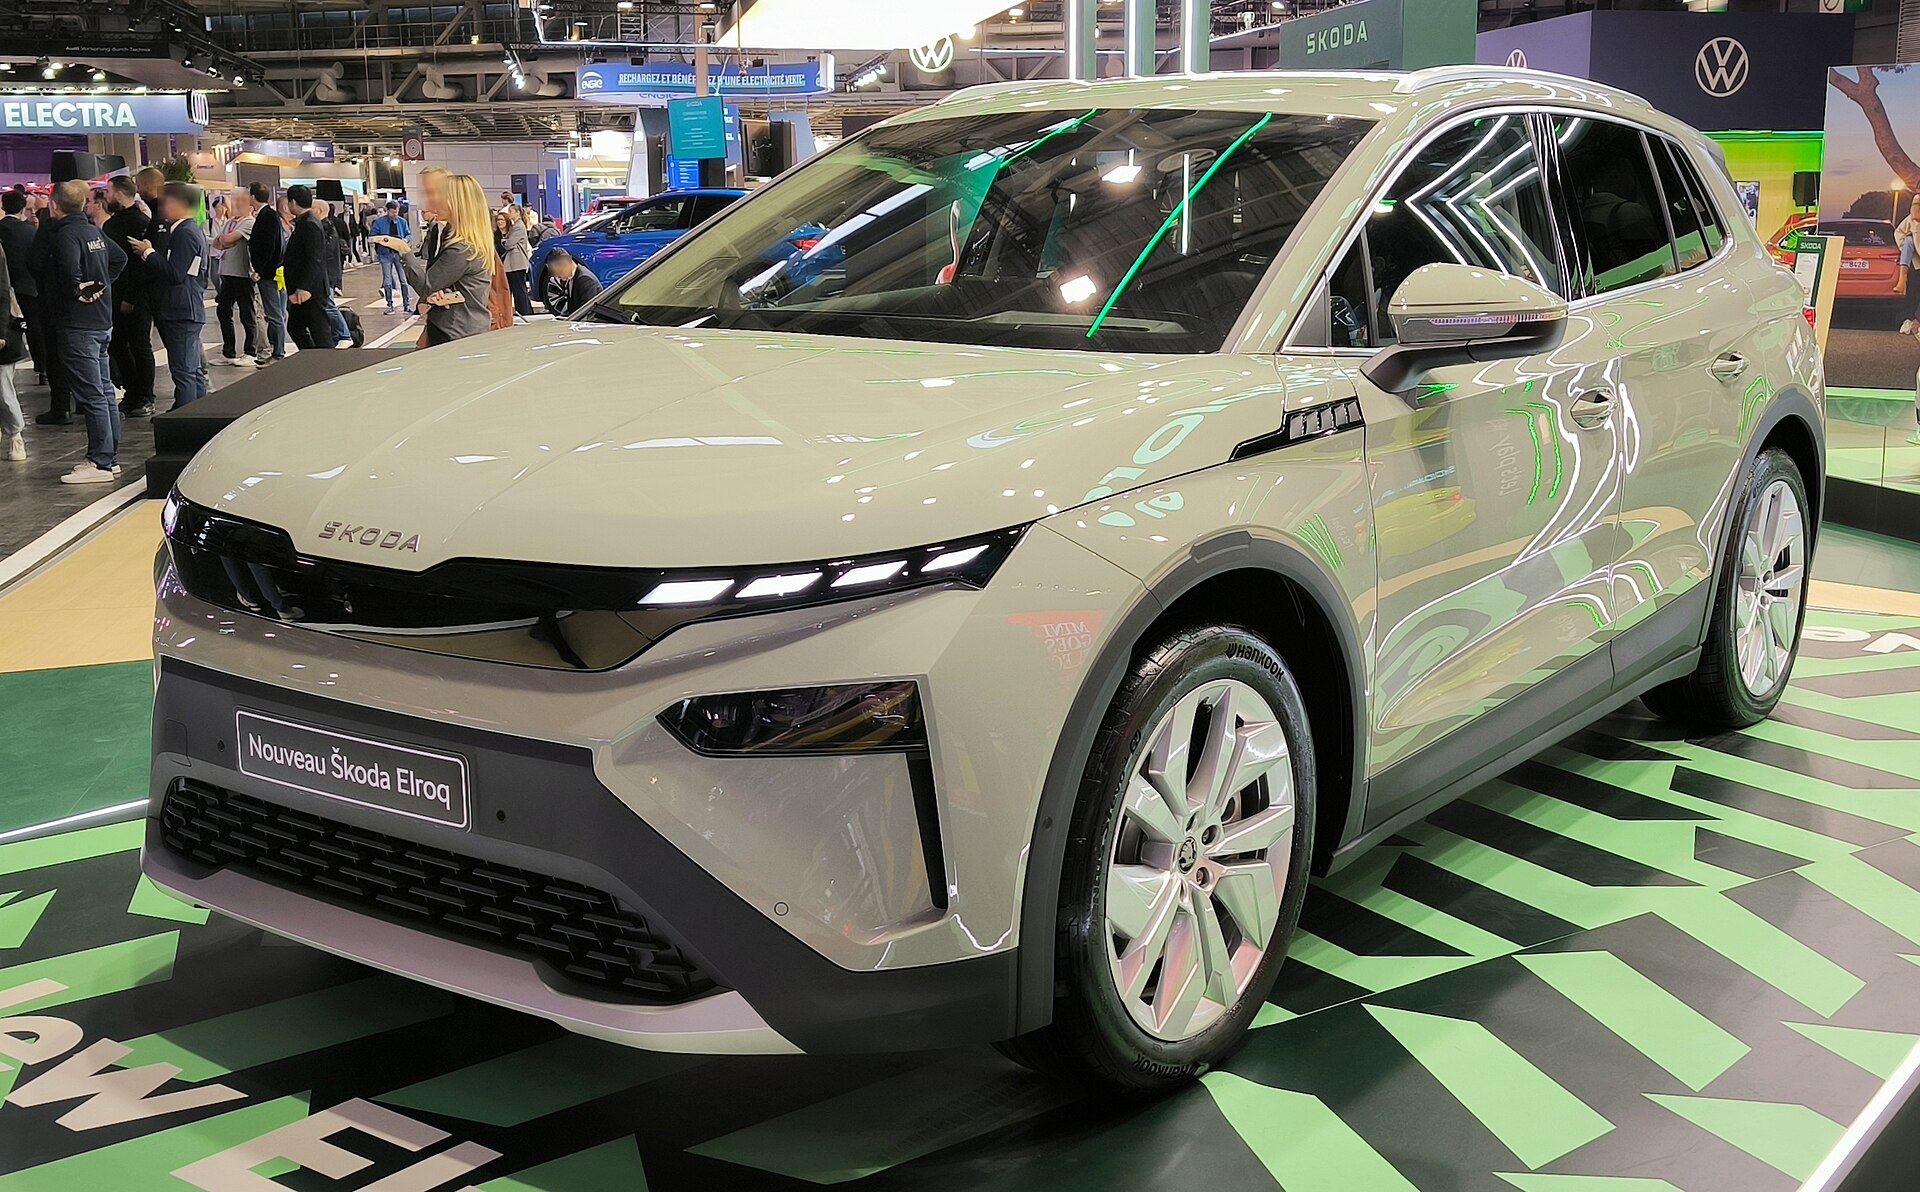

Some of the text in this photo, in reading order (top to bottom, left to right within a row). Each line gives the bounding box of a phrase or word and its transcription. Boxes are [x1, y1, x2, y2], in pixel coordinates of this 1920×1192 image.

[619, 73, 660, 84] RECHARGEZ
[661, 74, 671, 84] ET
[672, 72, 717, 86] BÉNÉFEZ
[4, 102, 137, 128] ELECTRA
[249, 733, 451, 810] Nouveau Škoda Elroq
